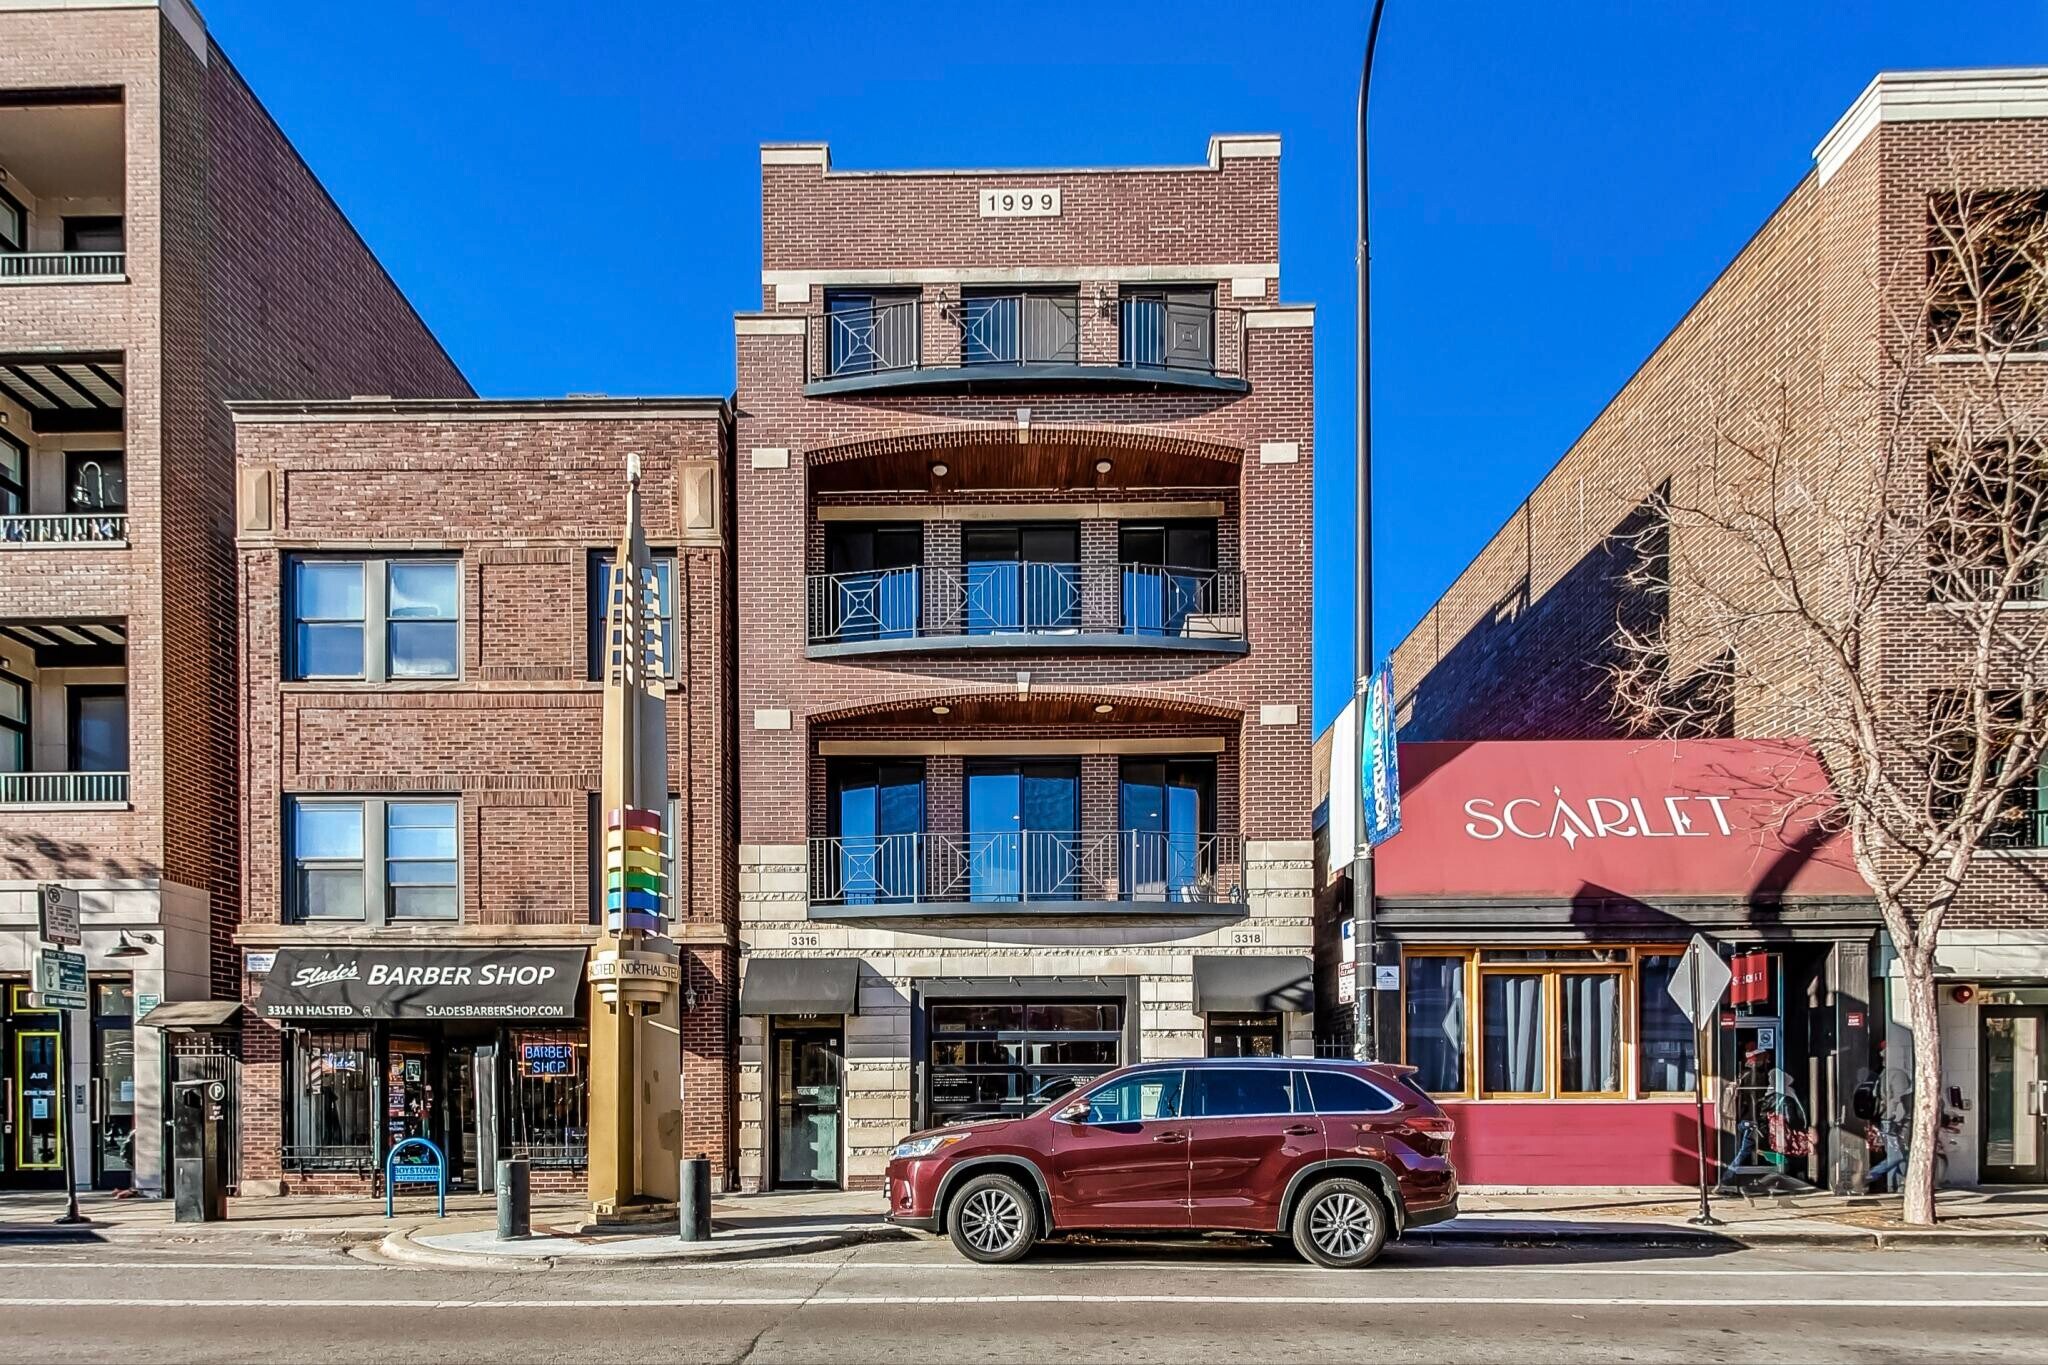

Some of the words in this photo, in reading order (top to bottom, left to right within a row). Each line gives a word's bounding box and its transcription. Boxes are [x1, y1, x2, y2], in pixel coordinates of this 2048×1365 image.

[988, 194, 1053, 211] 1999
[1464, 797, 1731, 841] SCARLET
[791, 936, 817, 946] 3316
[1234, 934, 1261, 943] 3318
[291, 961, 361, 987] Slade's
[367, 964, 472, 986] BARBER
[478, 964, 555, 985] SHOP
[621, 963, 679, 979] NORTHALSTED
[267, 1005, 292, 1015] 3314
[295, 1006, 304, 1015] N
[306, 1006, 353, 1015] HALSTED
[525, 1046, 572, 1058] BARBER
[533, 1061, 566, 1073] SHOP
